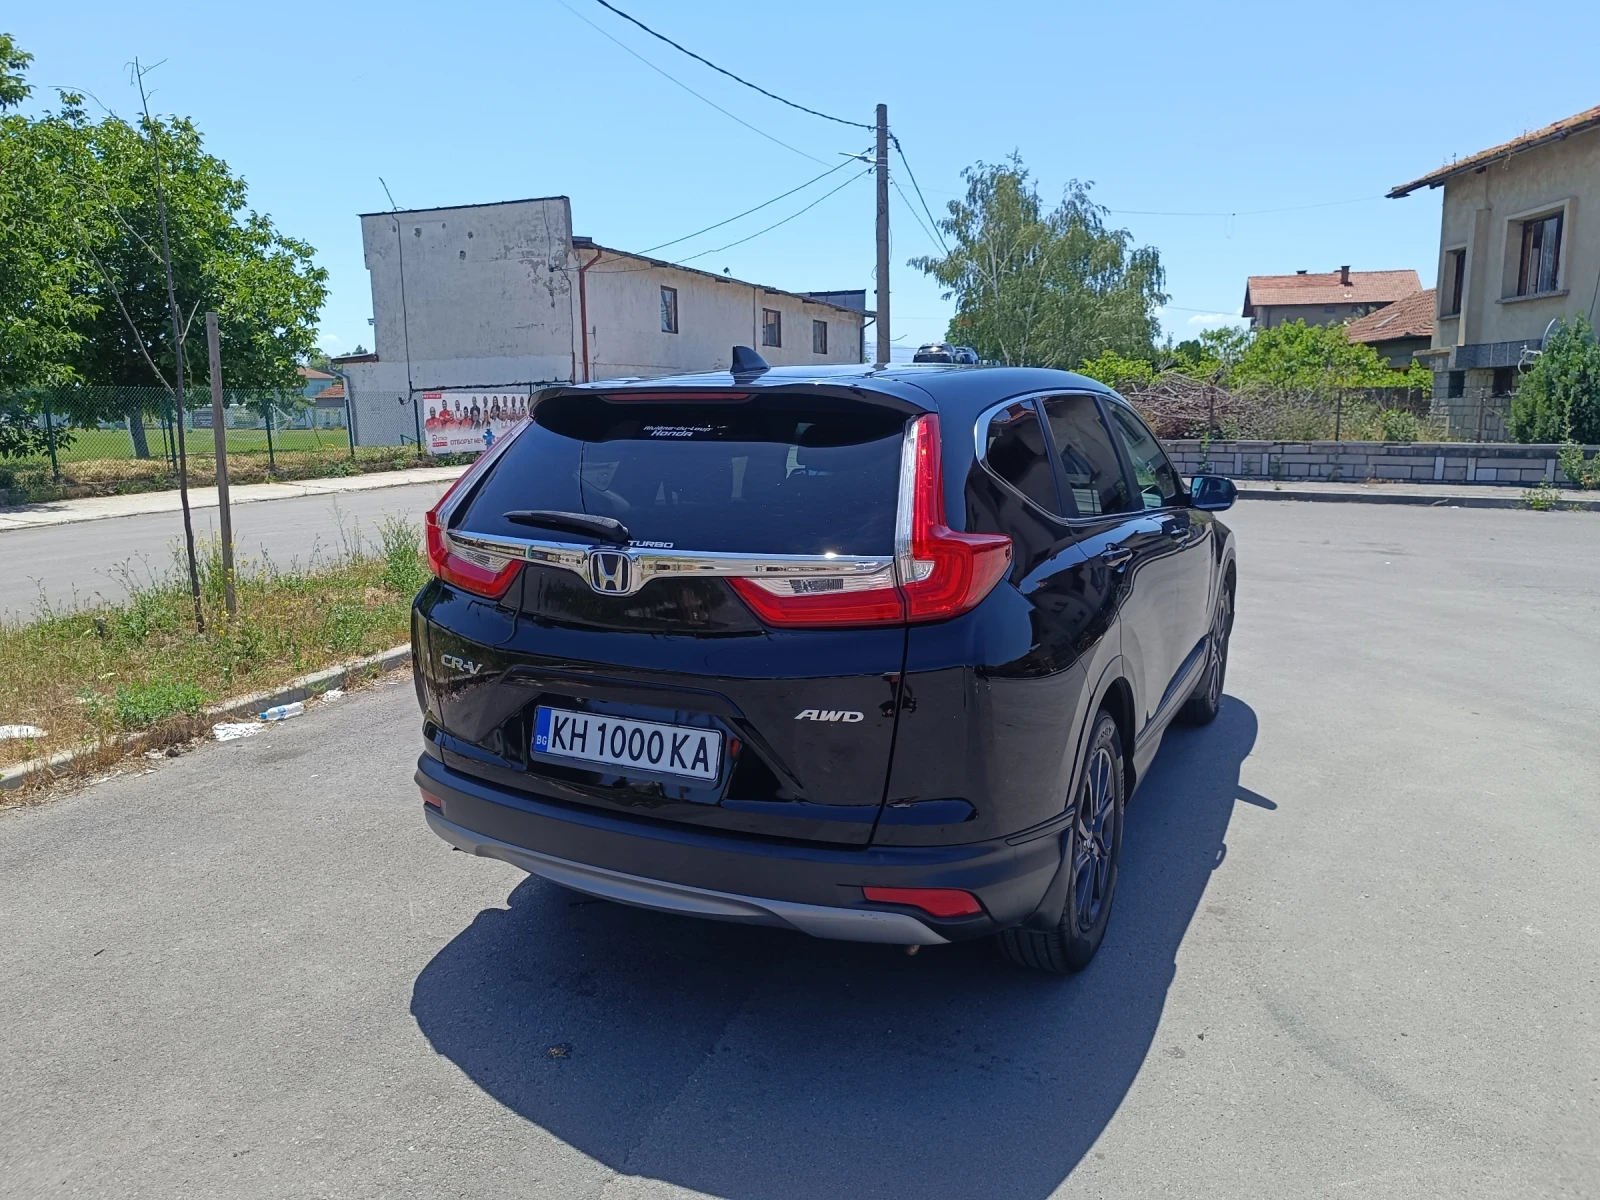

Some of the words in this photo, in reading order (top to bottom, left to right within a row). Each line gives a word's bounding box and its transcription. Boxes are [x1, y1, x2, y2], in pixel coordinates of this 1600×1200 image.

[628, 540, 674, 548] TURBO
[440, 654, 483, 675] CR-V
[794, 709, 864, 723] AWD
[536, 734, 548, 746] BG
[552, 715, 588, 753] KH
[597, 722, 664, 764] 1000
[669, 732, 709, 773] KA
